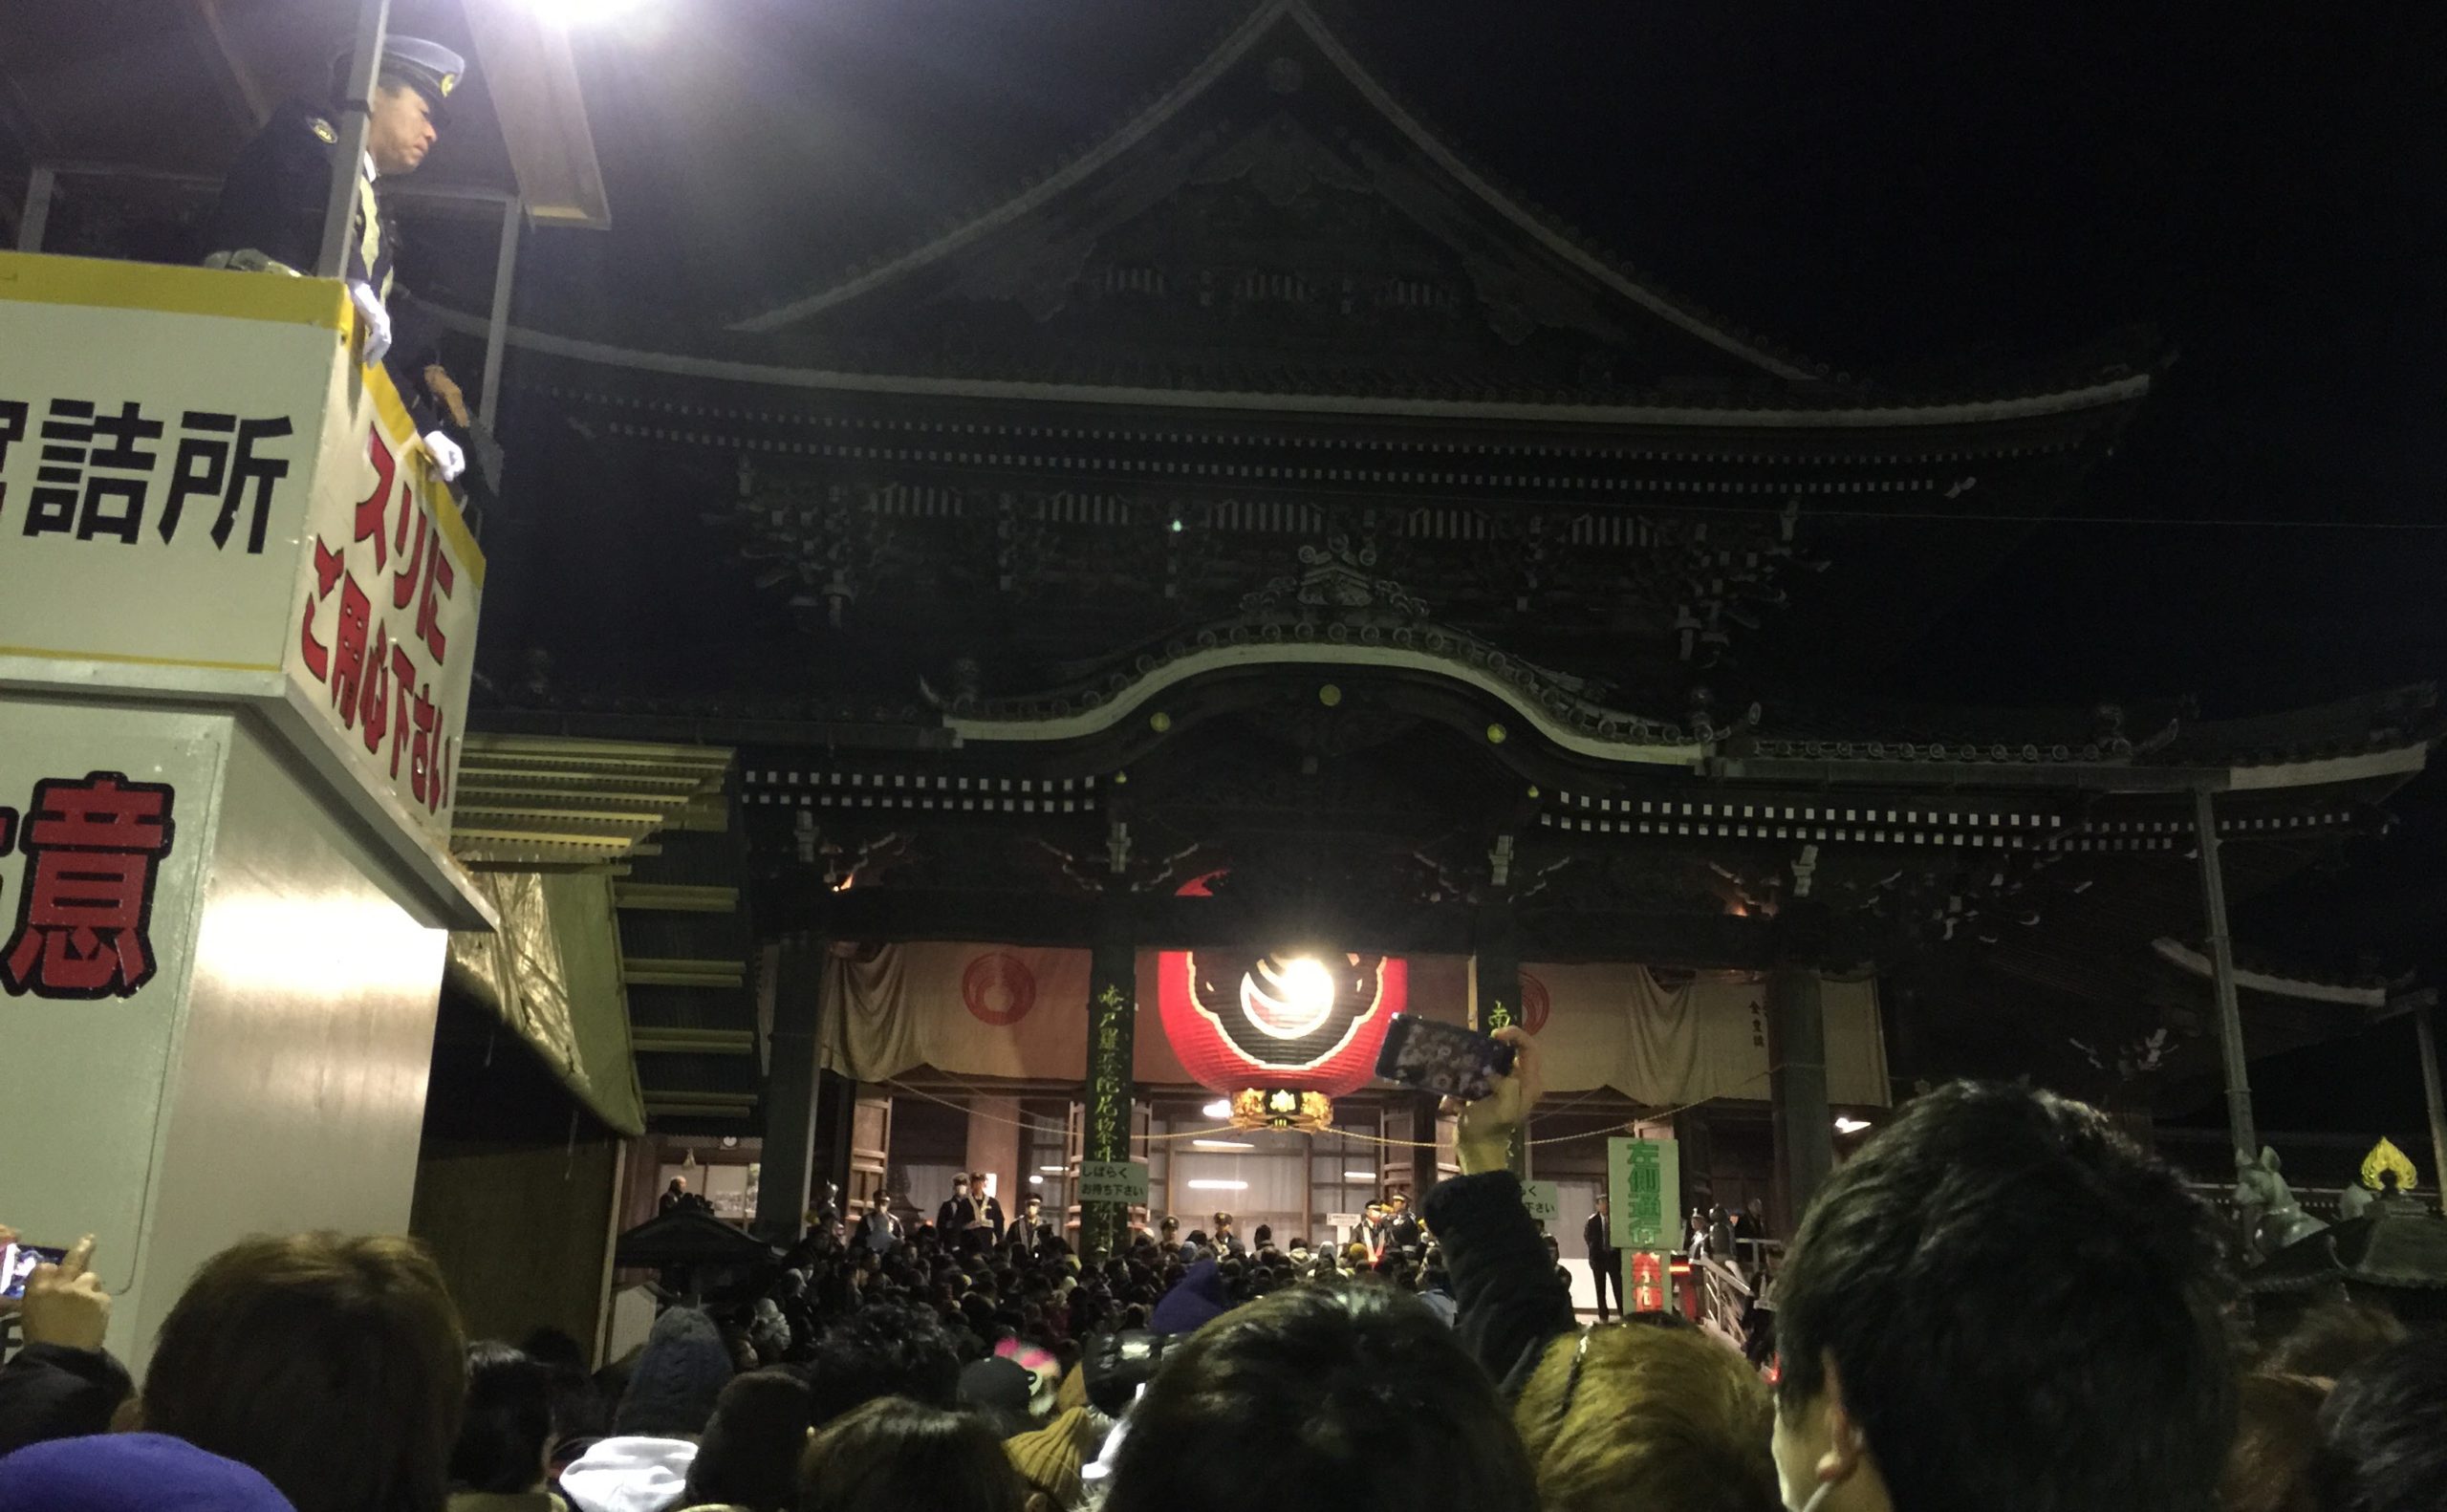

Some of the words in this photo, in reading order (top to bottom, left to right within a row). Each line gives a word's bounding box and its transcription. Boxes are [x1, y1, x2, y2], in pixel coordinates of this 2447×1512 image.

[0, 398, 293, 554] 詰所
[355, 421, 454, 666] スリに
[301, 533, 451, 815] ご用心下さい
[0, 769, 176, 1001] 意
[1081, 1183, 1144, 1197] お待ち下さい
[1082, 1166, 1128, 1179] しばらく
[1627, 1141, 1662, 1245] 左側通行
